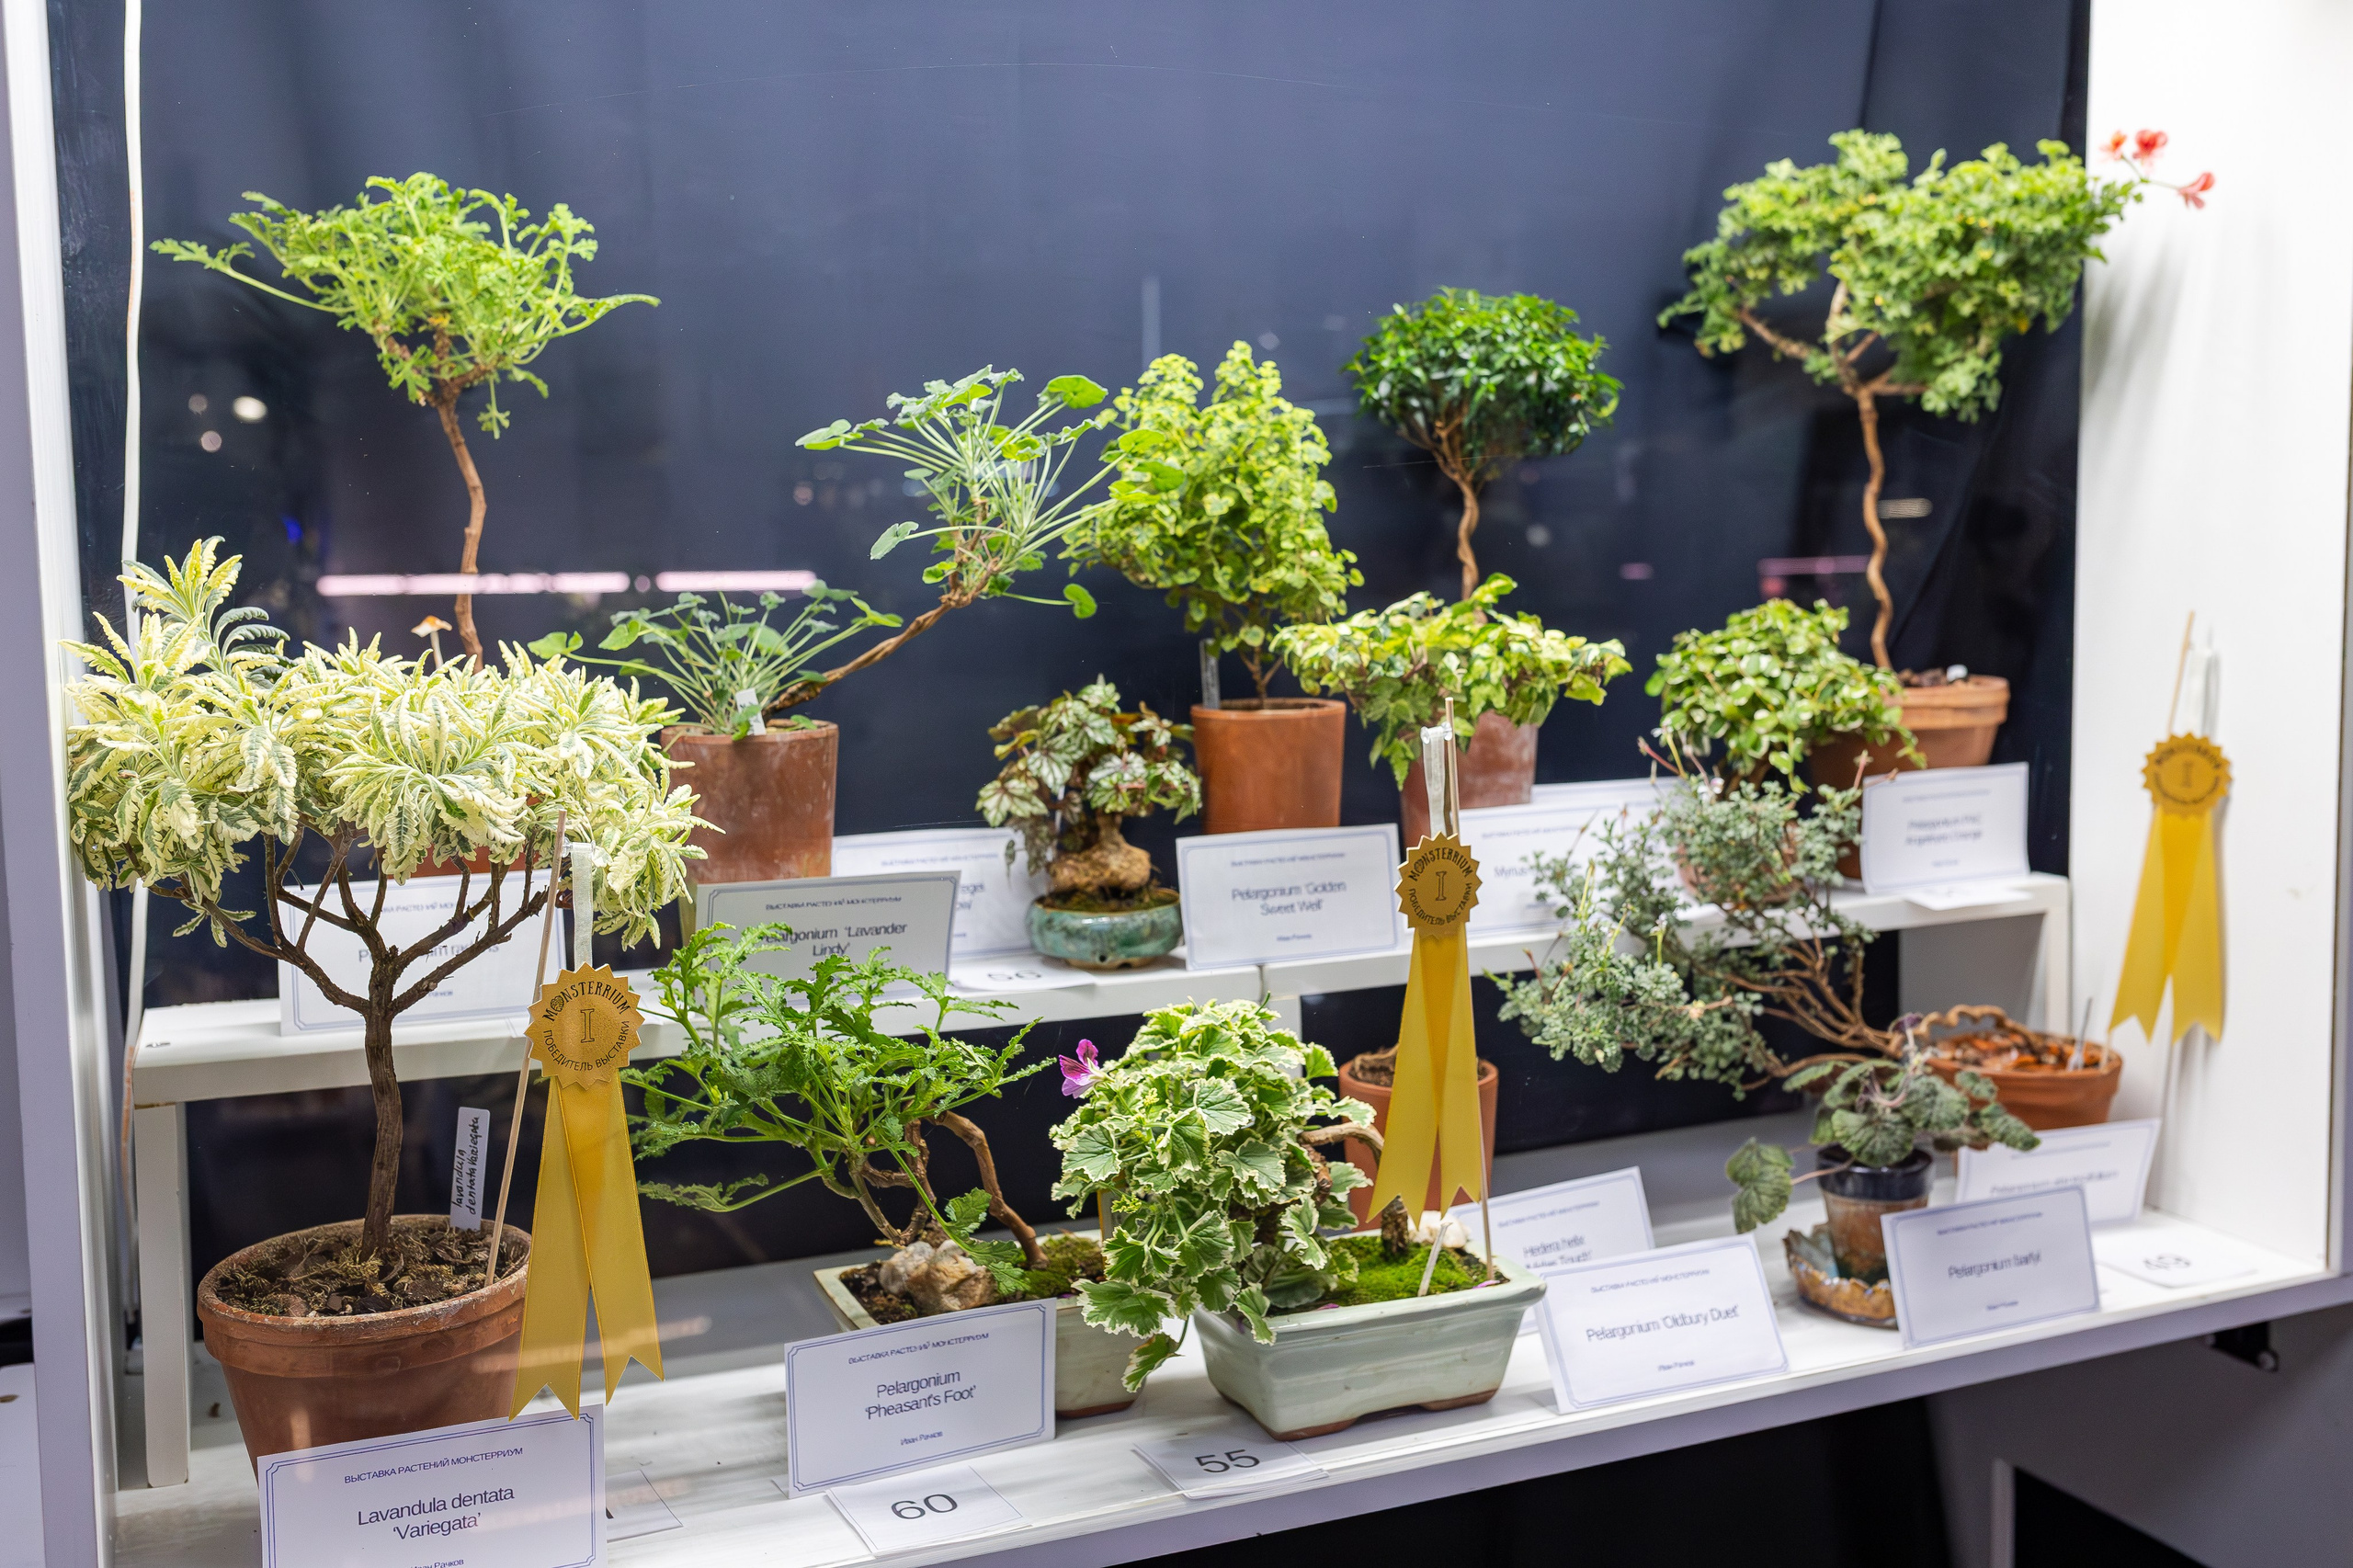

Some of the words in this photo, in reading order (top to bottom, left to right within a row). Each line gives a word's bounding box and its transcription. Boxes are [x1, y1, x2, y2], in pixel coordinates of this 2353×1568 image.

[542, 981, 631, 1022] MONSTERRIUM
[580, 1008, 595, 1043] I
[543, 1029, 594, 1072] ПОБЕДИТЕЛЬ
[595, 1020, 630, 1068] ВЫСТАВКИ
[1586, 1321, 1660, 1343] Pelargonium
[877, 1371, 961, 1398] Pelargonium
[345, 1468, 396, 1483] ВЫСТАВКА
[398, 1458, 449, 1474] РАСТЕНИЙ
[450, 1448, 523, 1466] МОНСТЕРРИУМ
[1195, 1449, 1260, 1472] 55
[358, 1497, 447, 1526] Lavandula
[451, 1488, 515, 1509] dentata
[892, 1494, 958, 1519] 60
